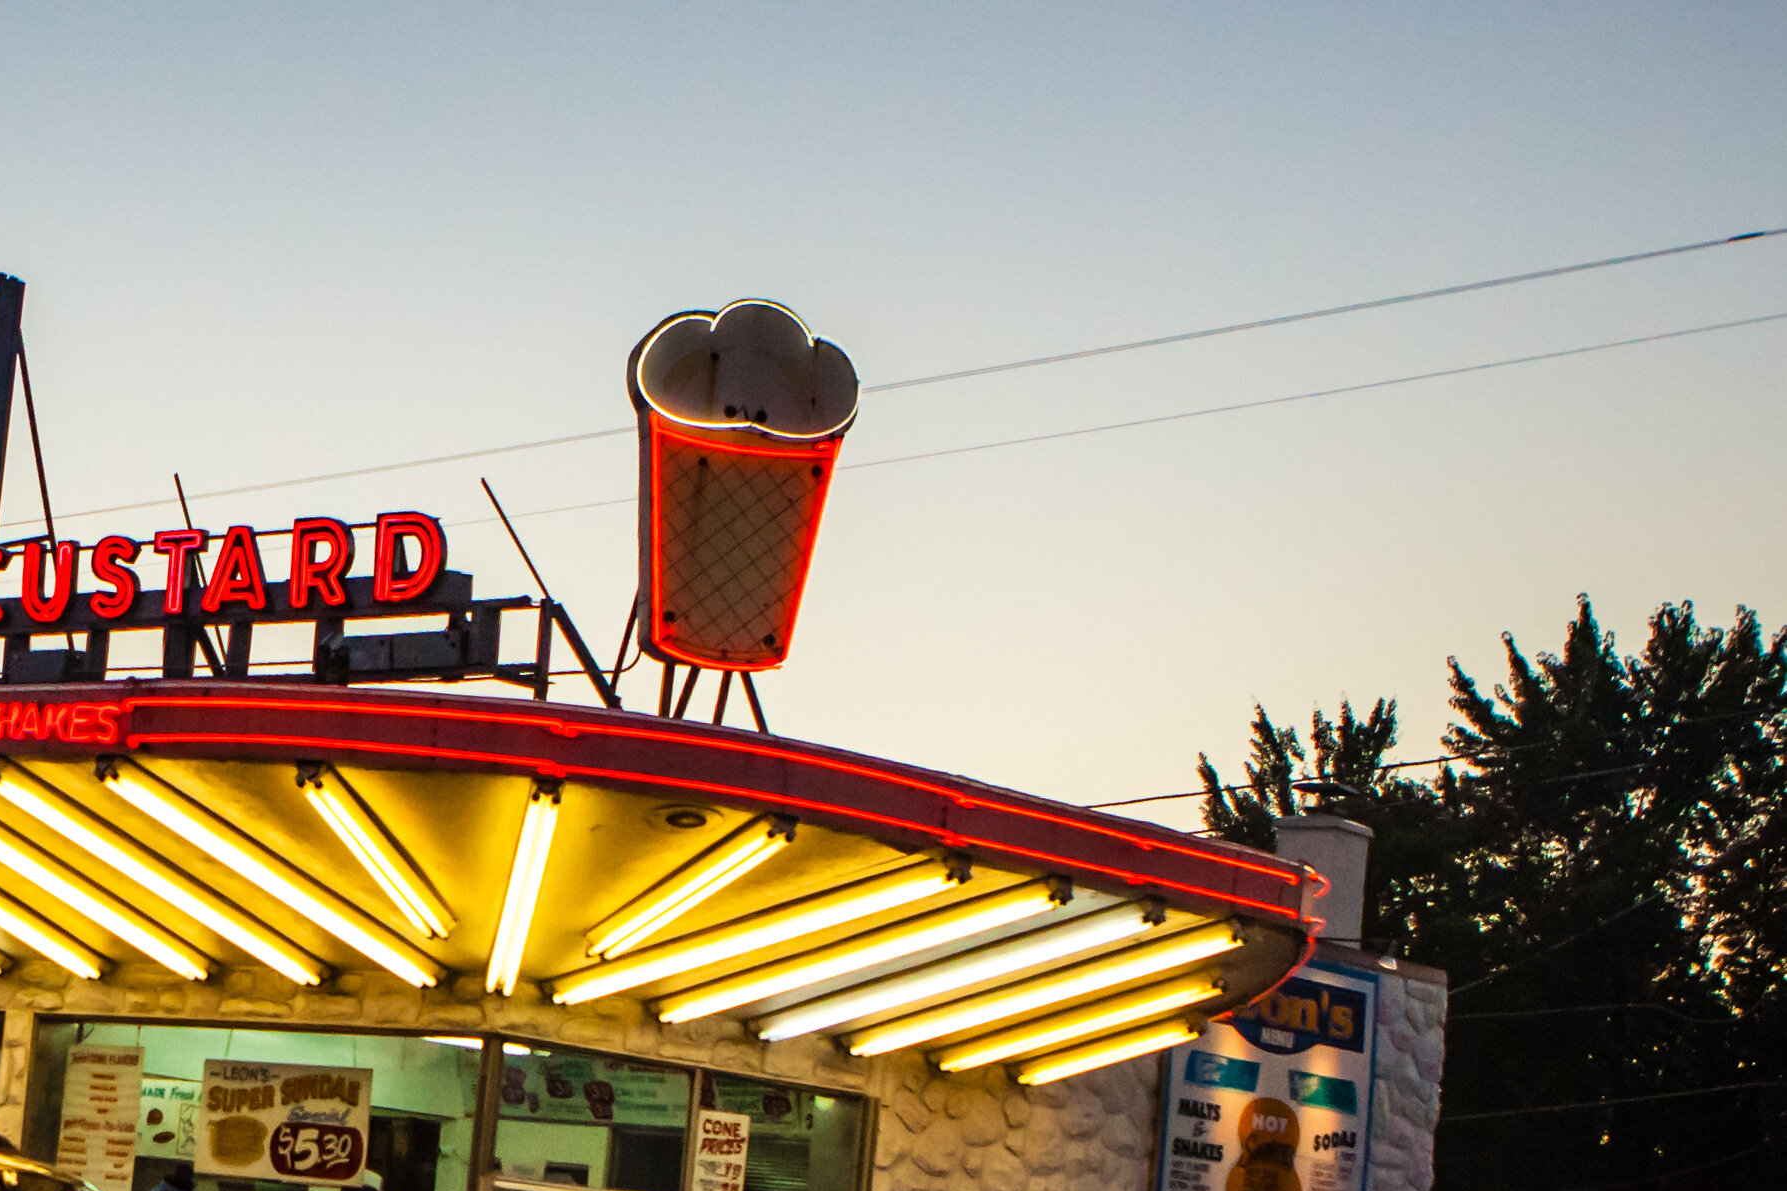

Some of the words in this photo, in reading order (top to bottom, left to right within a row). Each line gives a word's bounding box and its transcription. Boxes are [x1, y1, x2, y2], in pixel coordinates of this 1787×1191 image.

[207, 1084, 275, 1113] SUPER
[1178, 1098, 1221, 1122] MALTS
[702, 1118, 742, 1138] CONE
[1251, 1113, 1289, 1134] HOT
[277, 1125, 352, 1172] $5.30
[1173, 1137, 1223, 1162] SHAKES
[1313, 1131, 1357, 1152] SODAS
